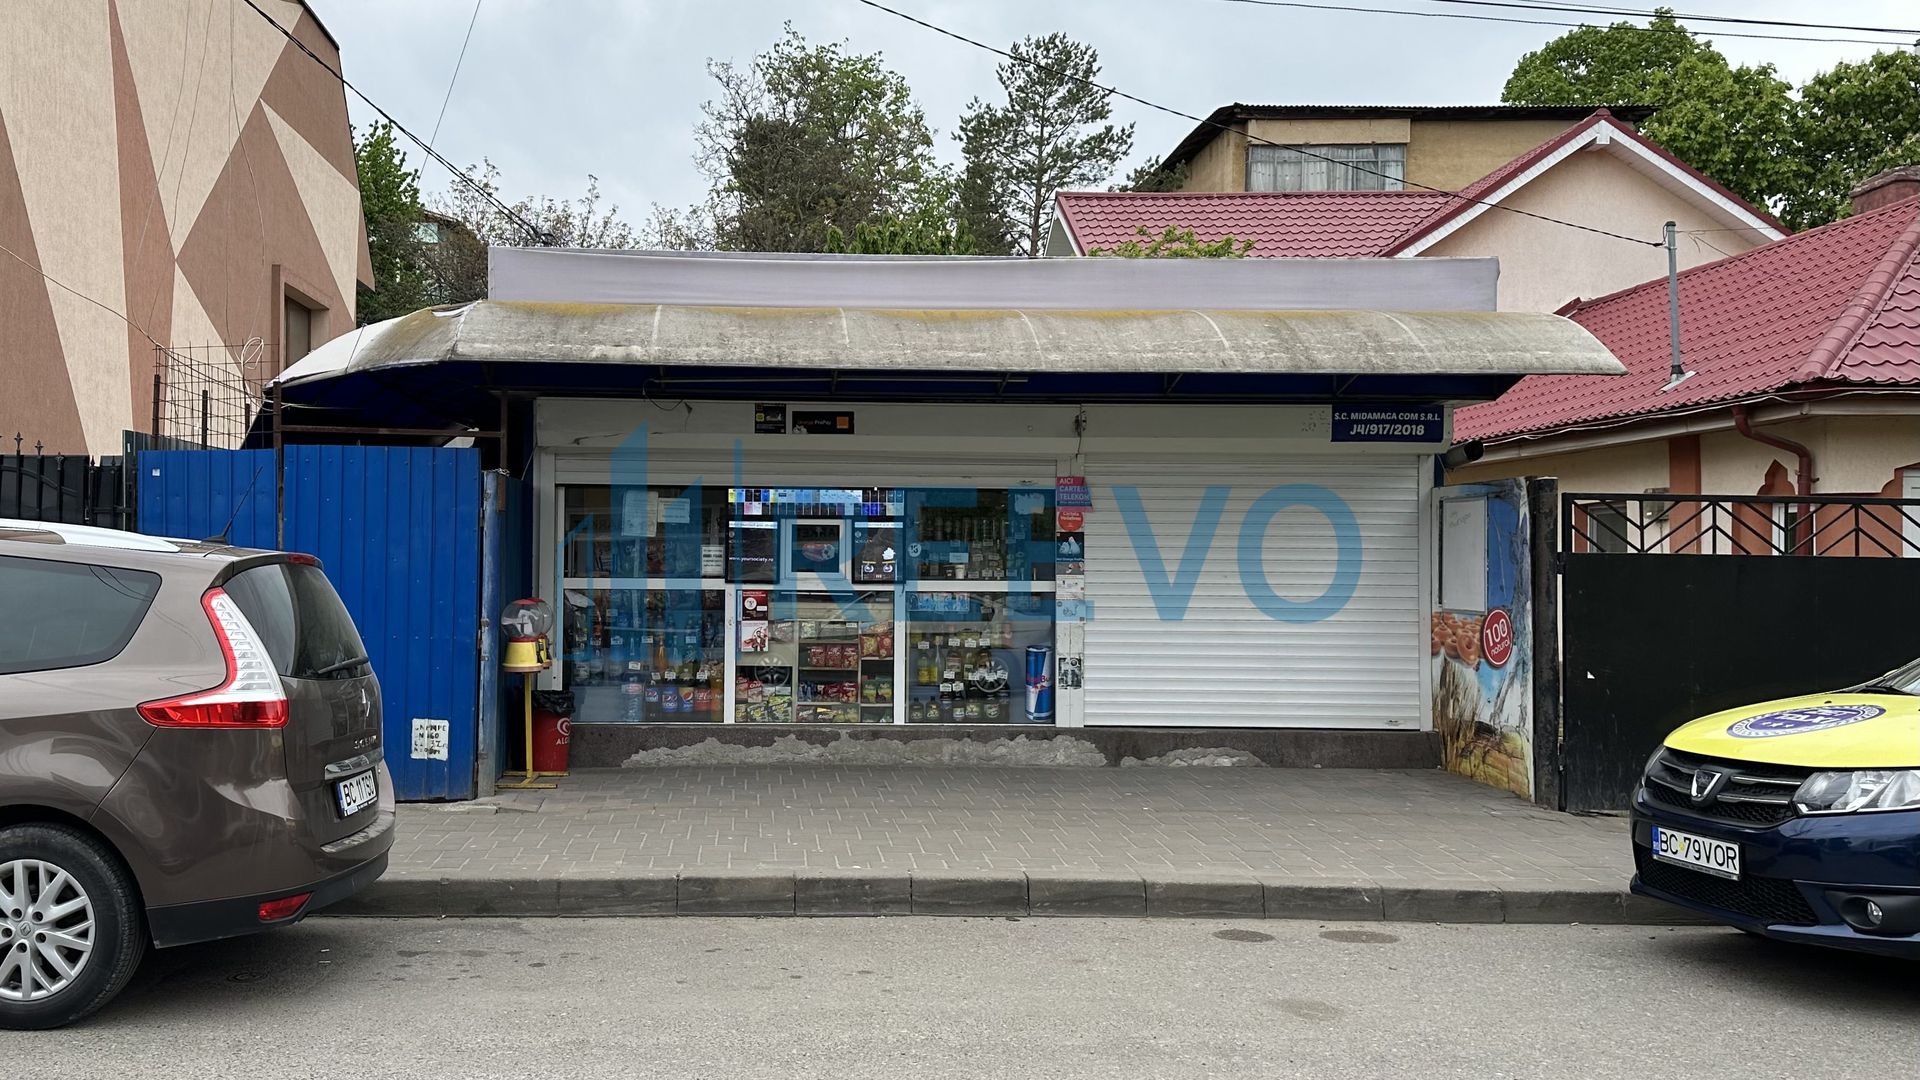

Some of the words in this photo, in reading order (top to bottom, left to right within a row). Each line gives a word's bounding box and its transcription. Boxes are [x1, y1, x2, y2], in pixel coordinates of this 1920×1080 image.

[1334, 412, 1349, 420] S.C.
[1419, 413, 1441, 421] S.R.L.
[1350, 423, 1425, 436] J4/917/2018
[1060, 477, 1074, 485] AICI
[1485, 618, 1508, 647] 100
[343, 781, 357, 807] BC
[1659, 830, 1679, 855] BC
